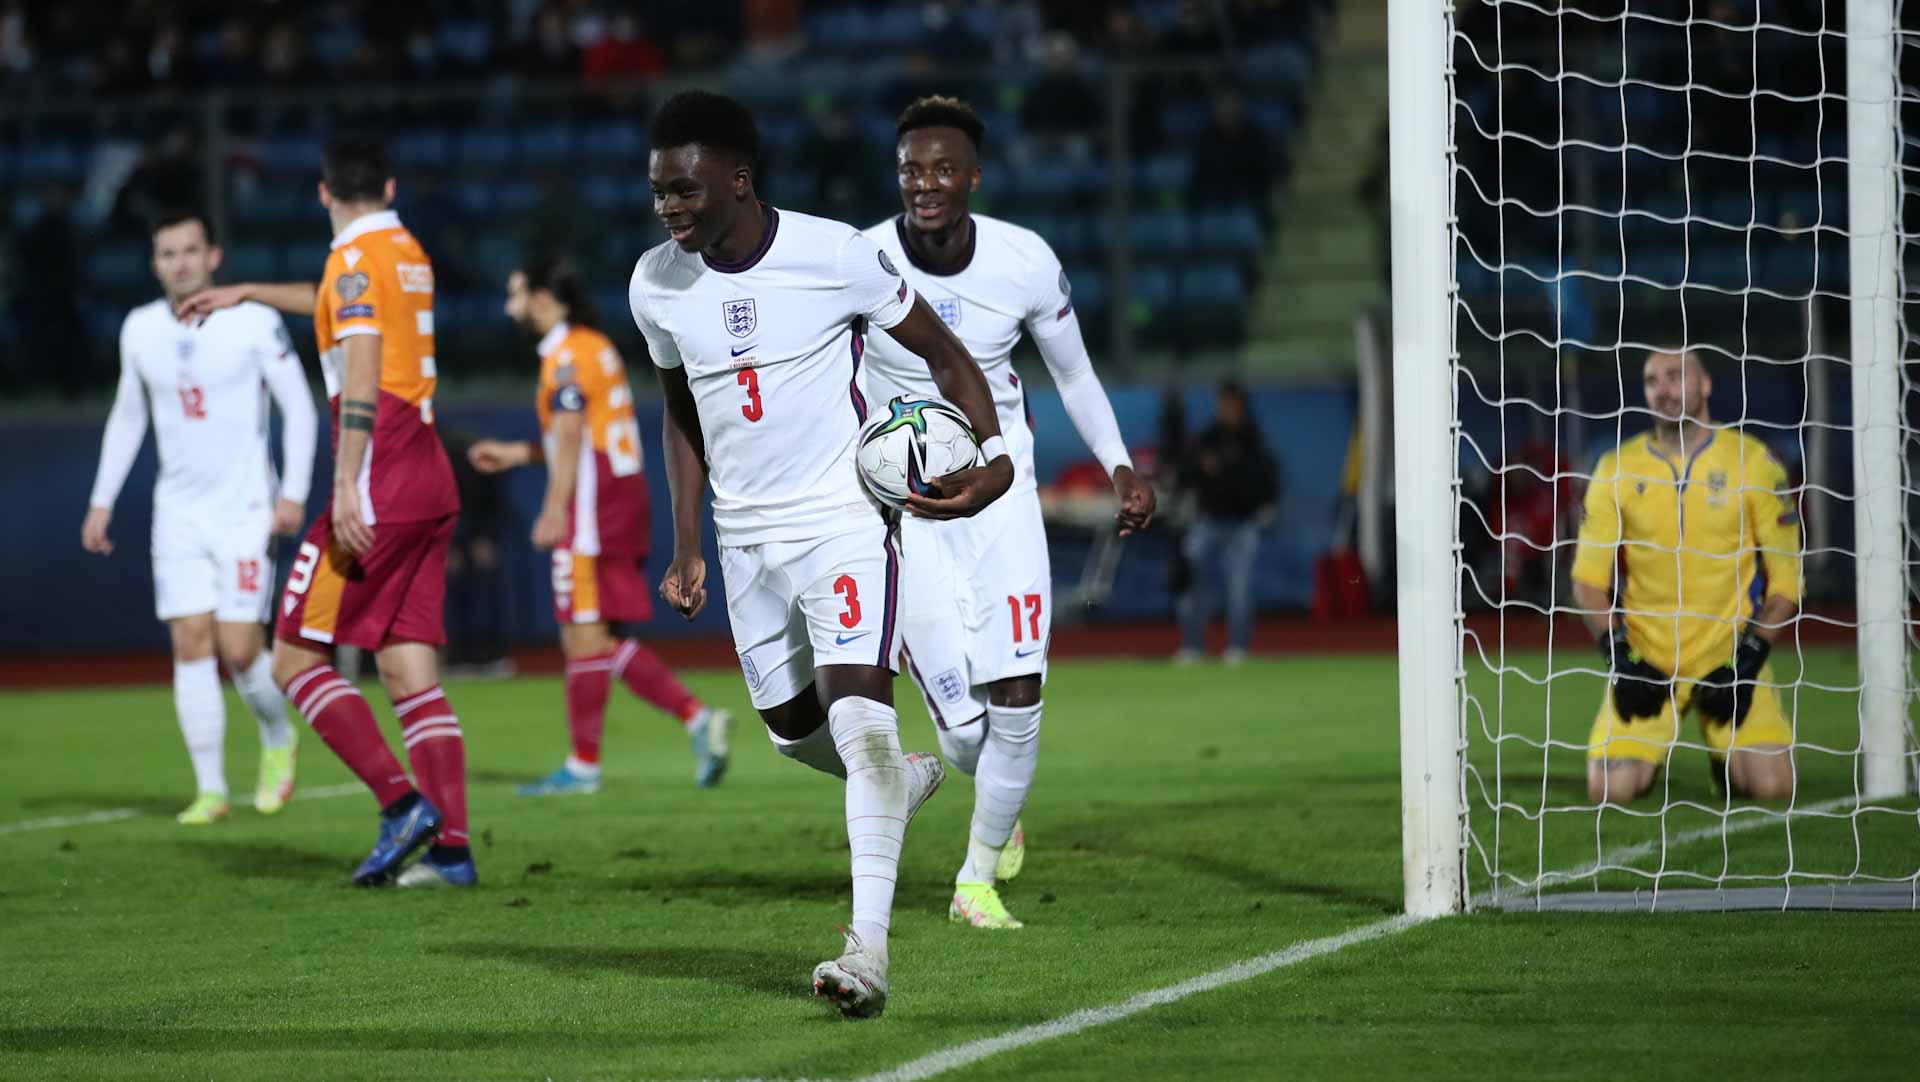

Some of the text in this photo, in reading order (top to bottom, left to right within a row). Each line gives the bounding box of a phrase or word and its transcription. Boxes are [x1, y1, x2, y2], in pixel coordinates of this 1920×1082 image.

[179, 387, 207, 418] 12
[737, 367, 763, 422] 3
[236, 559, 260, 592] 12
[286, 541, 320, 594] 3
[833, 574, 861, 629] 3
[1007, 594, 1042, 643] 17
